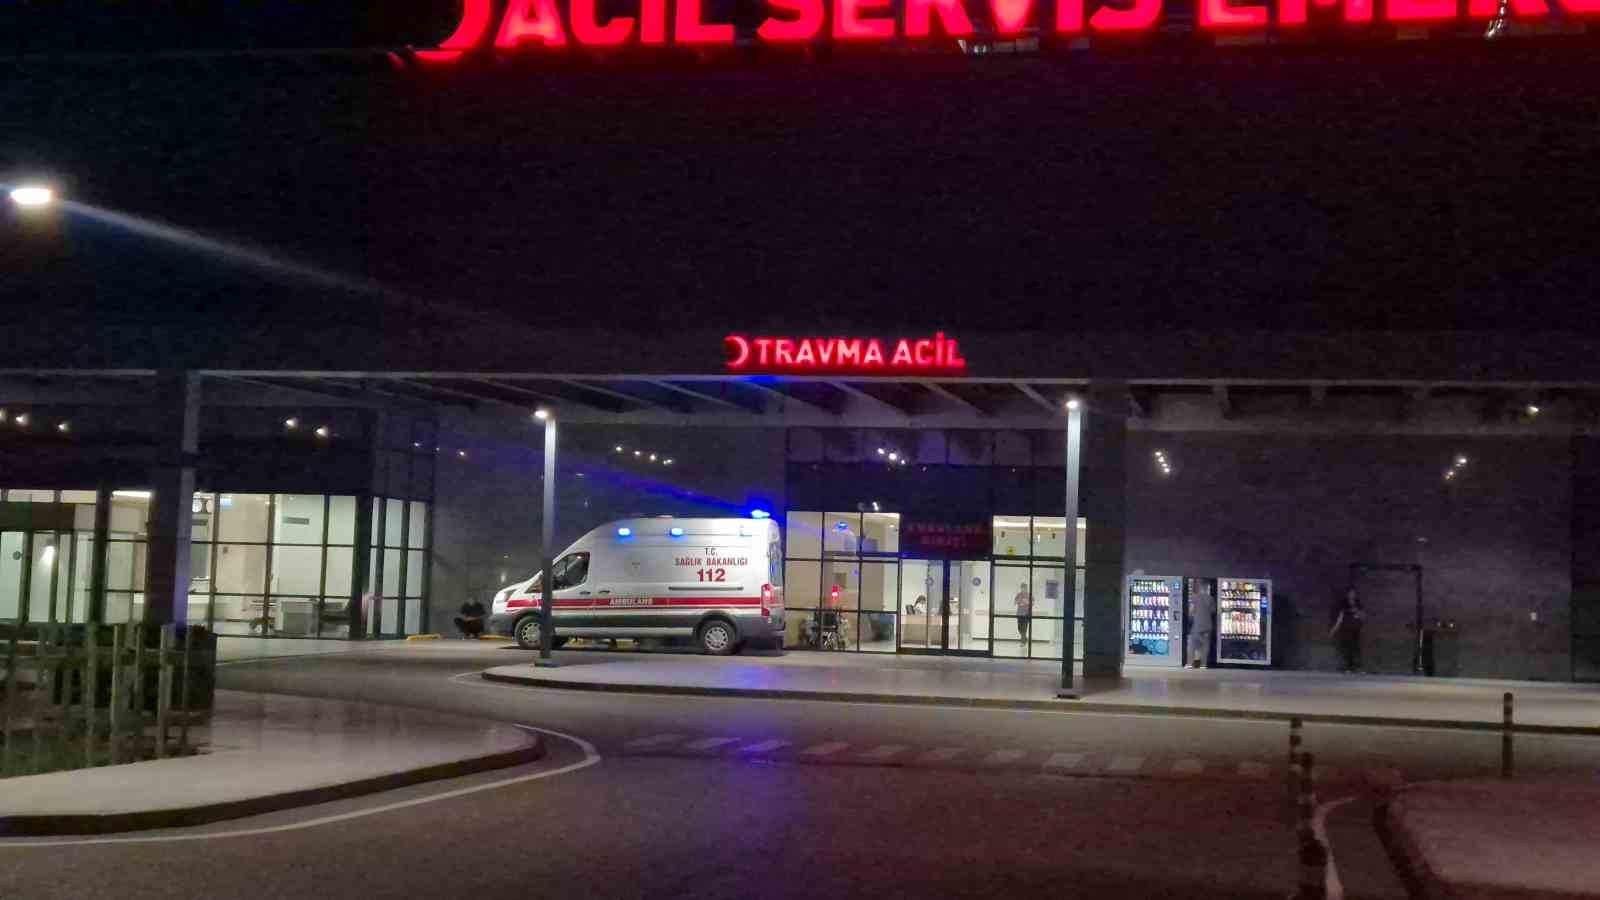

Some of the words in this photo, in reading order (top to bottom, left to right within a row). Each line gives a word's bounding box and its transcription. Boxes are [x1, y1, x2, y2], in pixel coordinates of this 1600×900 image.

[753, 338, 882, 366] TRAVMA
[891, 331, 966, 368] ACİL
[675, 556, 702, 566] SAĞLIK
[706, 556, 748, 566] BAKANLIĞI
[697, 568, 726, 582] 112
